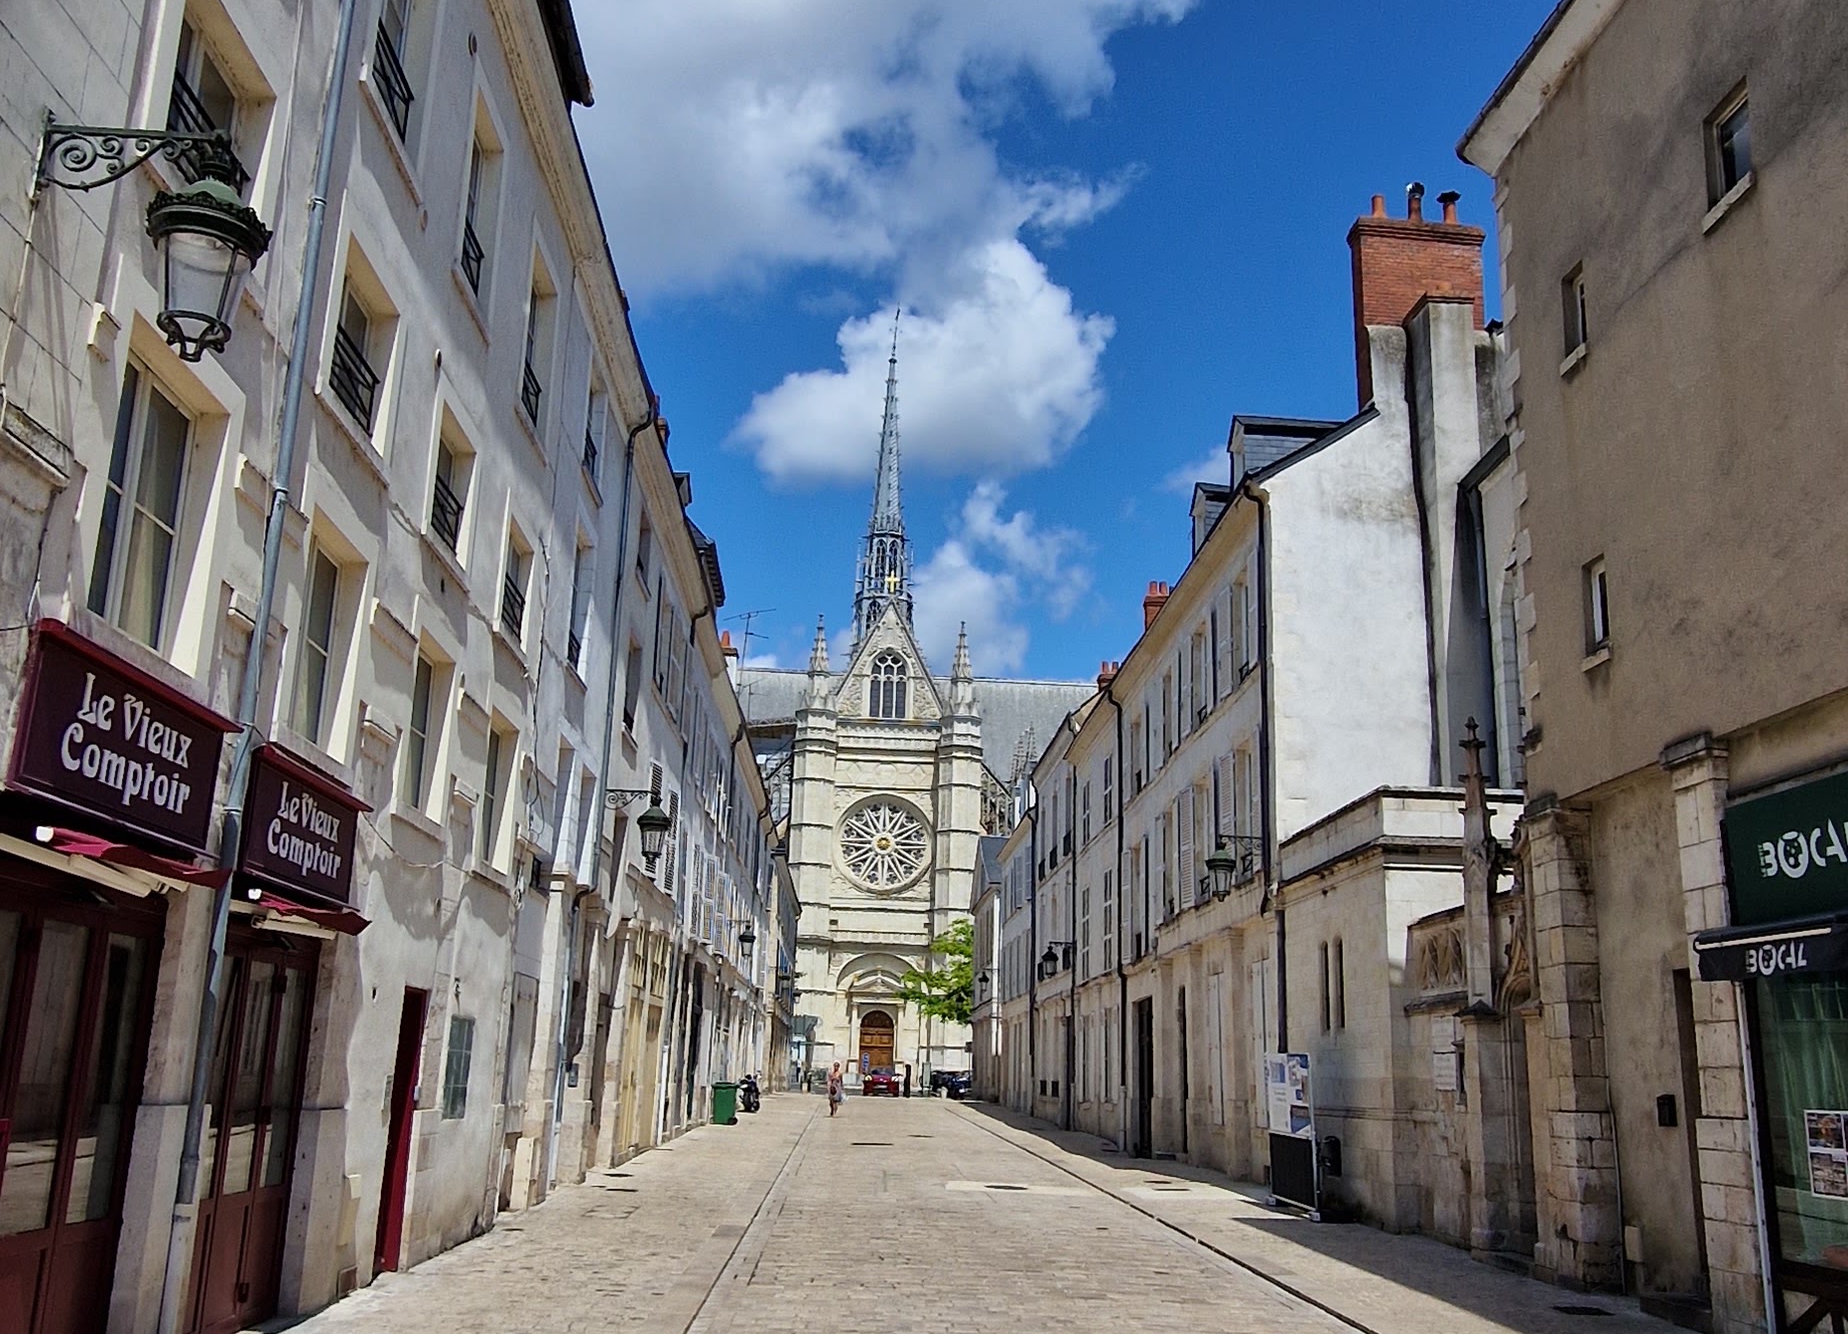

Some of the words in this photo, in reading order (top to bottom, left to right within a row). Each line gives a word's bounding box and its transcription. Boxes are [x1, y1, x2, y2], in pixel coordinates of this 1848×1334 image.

[77, 672, 116, 731] Le
[123, 693, 193, 769] Vieux
[61, 722, 191, 815] Comptoir
[277, 781, 300, 824] Le
[301, 792, 341, 844] Vieux
[267, 818, 341, 879] Comptoir
[1762, 817, 1848, 879] BOCA
[1748, 940, 1808, 976] BOCAL
